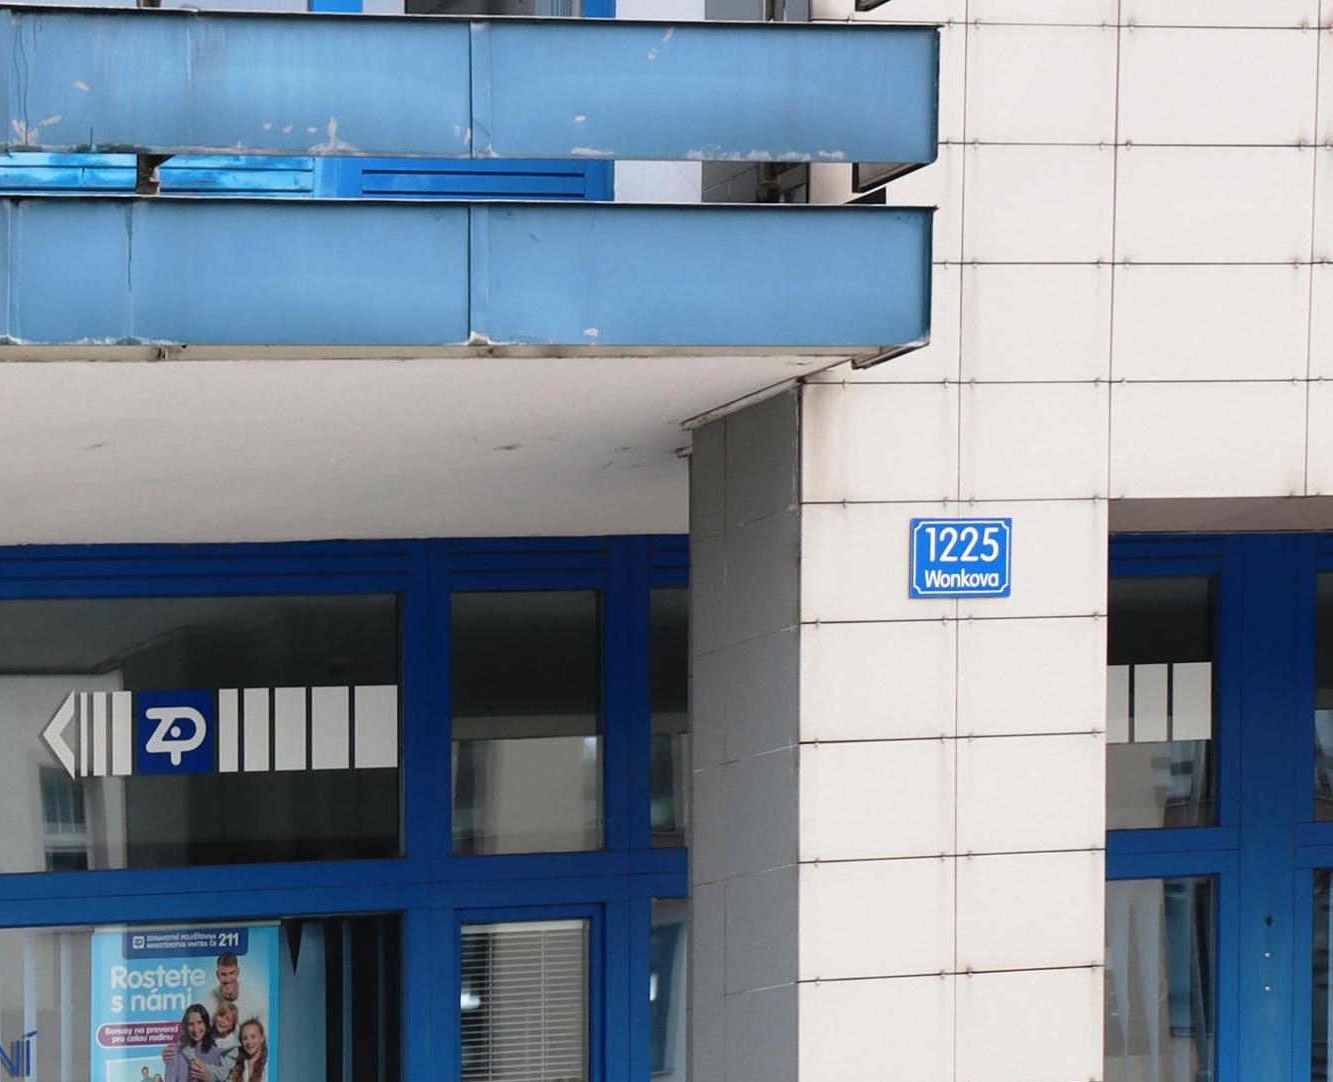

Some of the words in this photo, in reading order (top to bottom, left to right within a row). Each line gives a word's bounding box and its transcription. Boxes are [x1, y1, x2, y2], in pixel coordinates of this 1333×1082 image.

[925, 527, 1000, 563] 1225
[924, 568, 1000, 589] Wonkova
[218, 932, 239, 947] 211
[110, 964, 207, 989] Rostete
[110, 994, 125, 1013] s
[130, 988, 193, 1012] námi
[105, 1026, 132, 1037] Bonusy
[111, 1036, 125, 1044] pro
[127, 1034, 148, 1042] celou
[148, 1032, 174, 1042] rodinu
